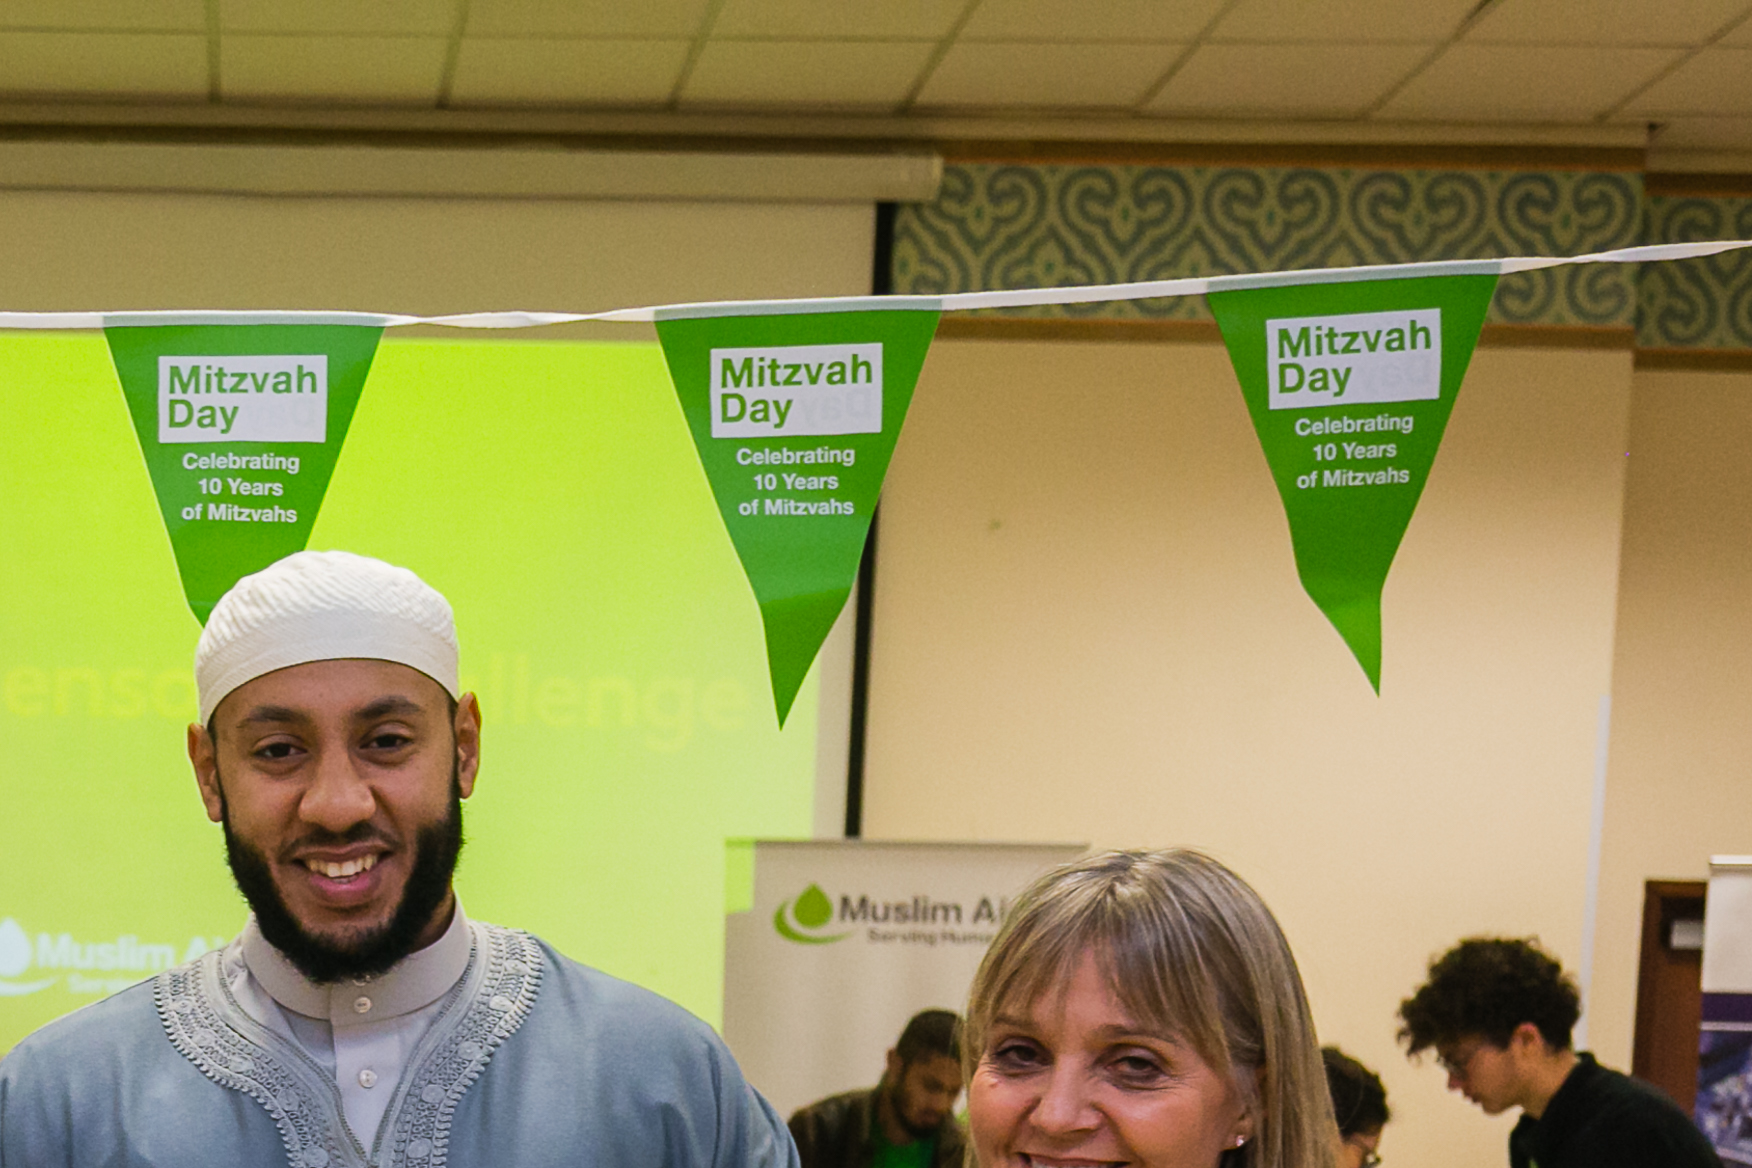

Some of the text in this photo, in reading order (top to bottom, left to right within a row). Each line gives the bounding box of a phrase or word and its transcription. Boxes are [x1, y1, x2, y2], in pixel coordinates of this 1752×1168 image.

[1277, 320, 1431, 359] Mitzvah
[169, 365, 317, 394] Mitzvah
[721, 354, 872, 389] Mitzvah
[1278, 362, 1352, 397] Day
[168, 399, 239, 434] Day
[721, 393, 794, 429] Day
[1295, 414, 1414, 436] Celebrating
[736, 447, 855, 466] Celebrating
[1313, 442, 1397, 461] 10 Years
[182, 452, 300, 475] Celebrating
[198, 477, 284, 496] 10 Years
[753, 473, 839, 490] 10 Years
[1296, 467, 1409, 489] of Mitzvahs
[181, 503, 298, 523] of Mitzvahs
[738, 498, 854, 516] of Mitzvahs
[840, 895, 1008, 923] Muslim Ai
[36, 932, 175, 970] Muslim
